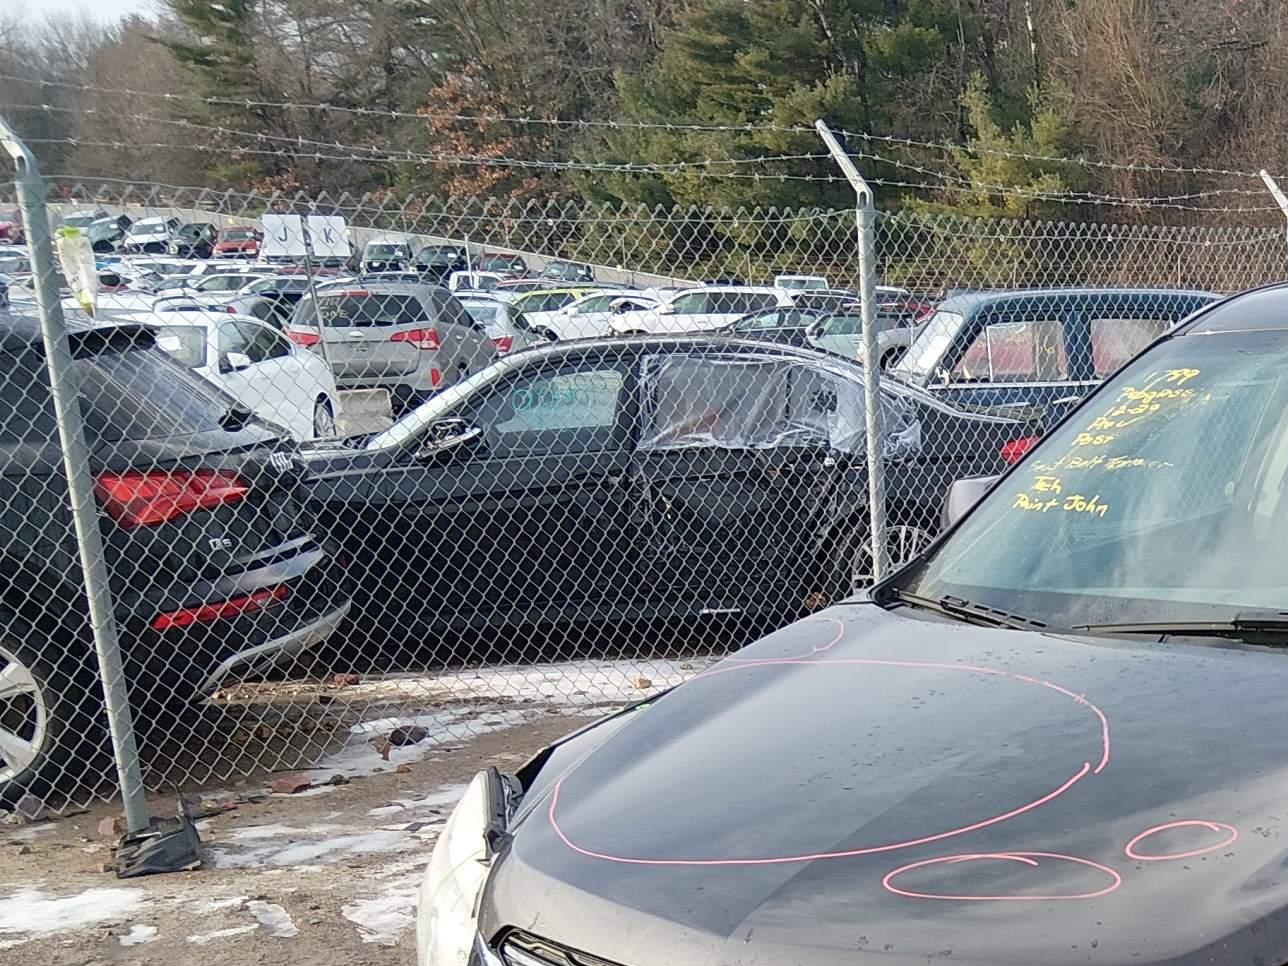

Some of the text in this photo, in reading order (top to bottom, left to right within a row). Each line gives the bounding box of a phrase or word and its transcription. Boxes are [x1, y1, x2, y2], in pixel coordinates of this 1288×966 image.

[278, 226, 288, 242] J
[323, 227, 335, 243] K
[1062, 494, 1109, 518] John
